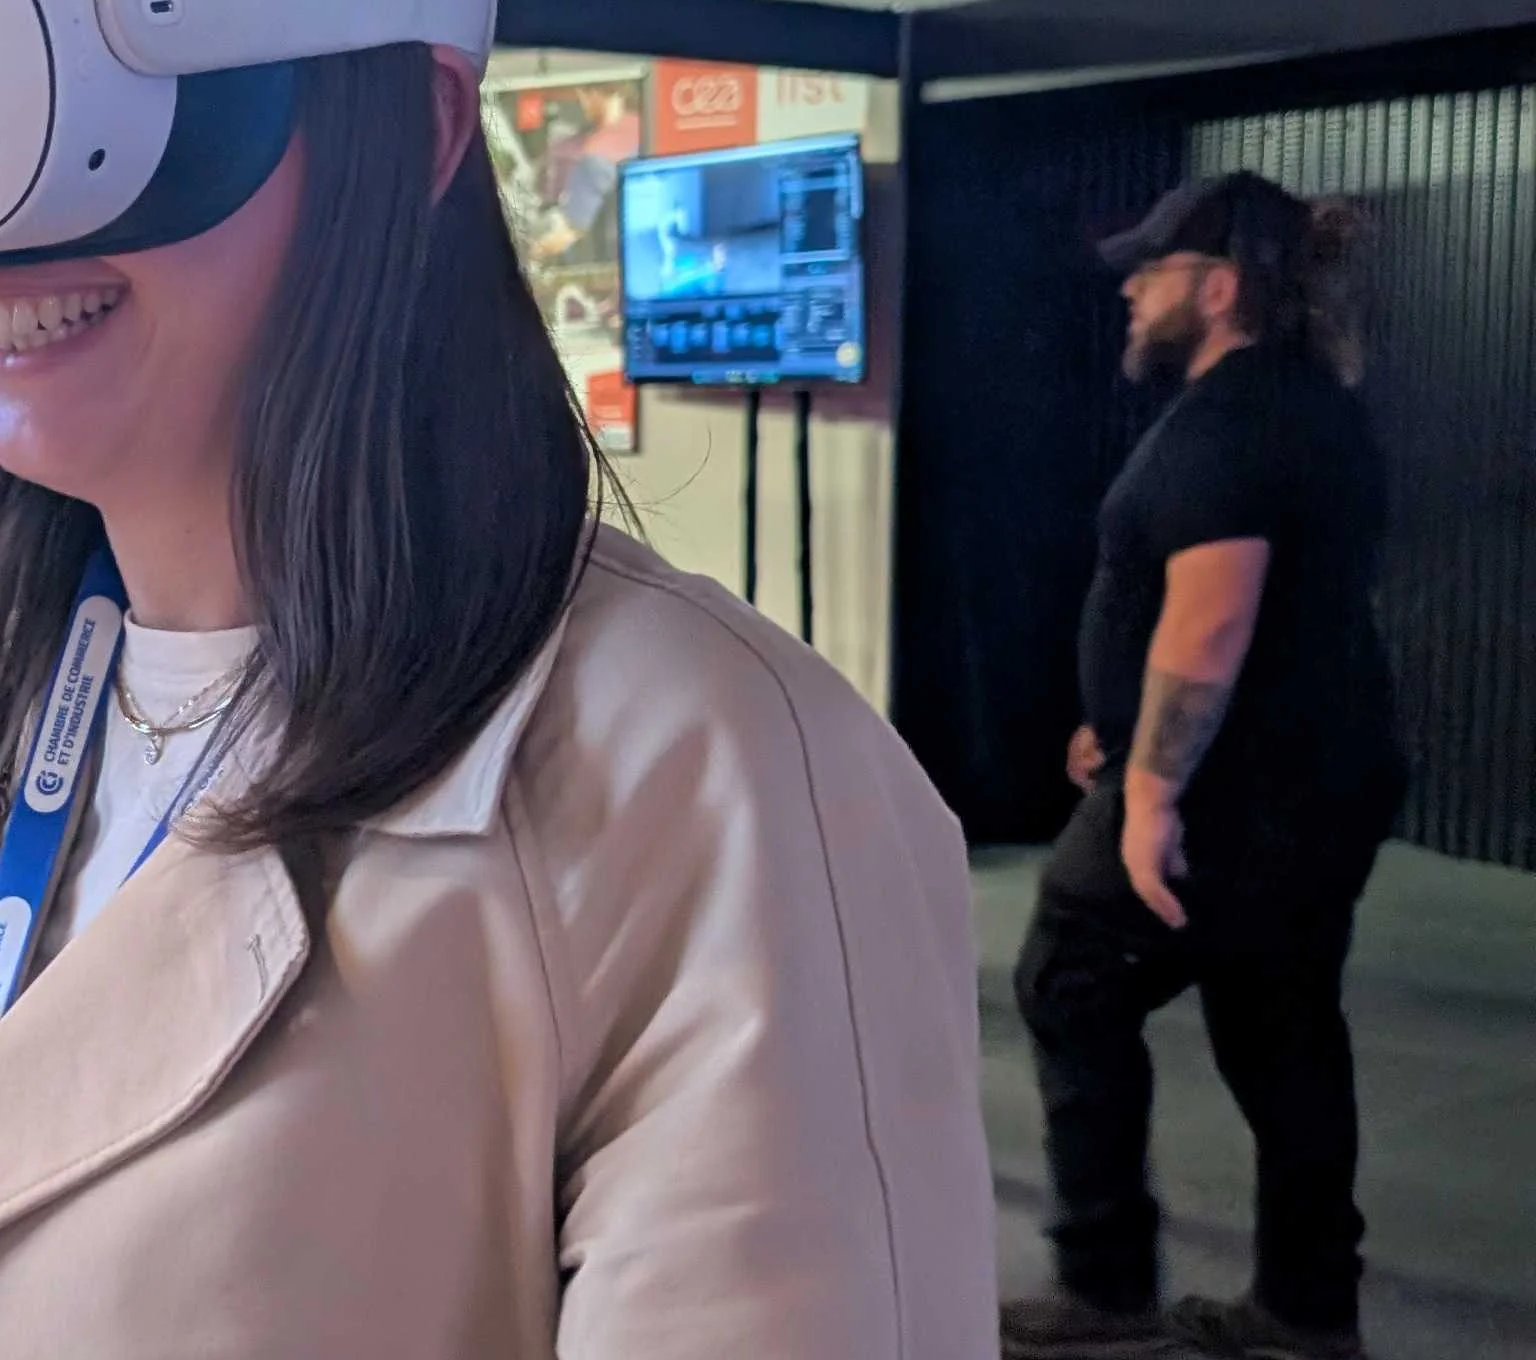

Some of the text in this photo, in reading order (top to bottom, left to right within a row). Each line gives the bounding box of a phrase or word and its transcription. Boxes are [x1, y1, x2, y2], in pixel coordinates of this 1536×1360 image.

[44, 616, 96, 763] CHAMBRE DE COMMERCE
[57, 674, 94, 766] ET D'INDUSTRIE
